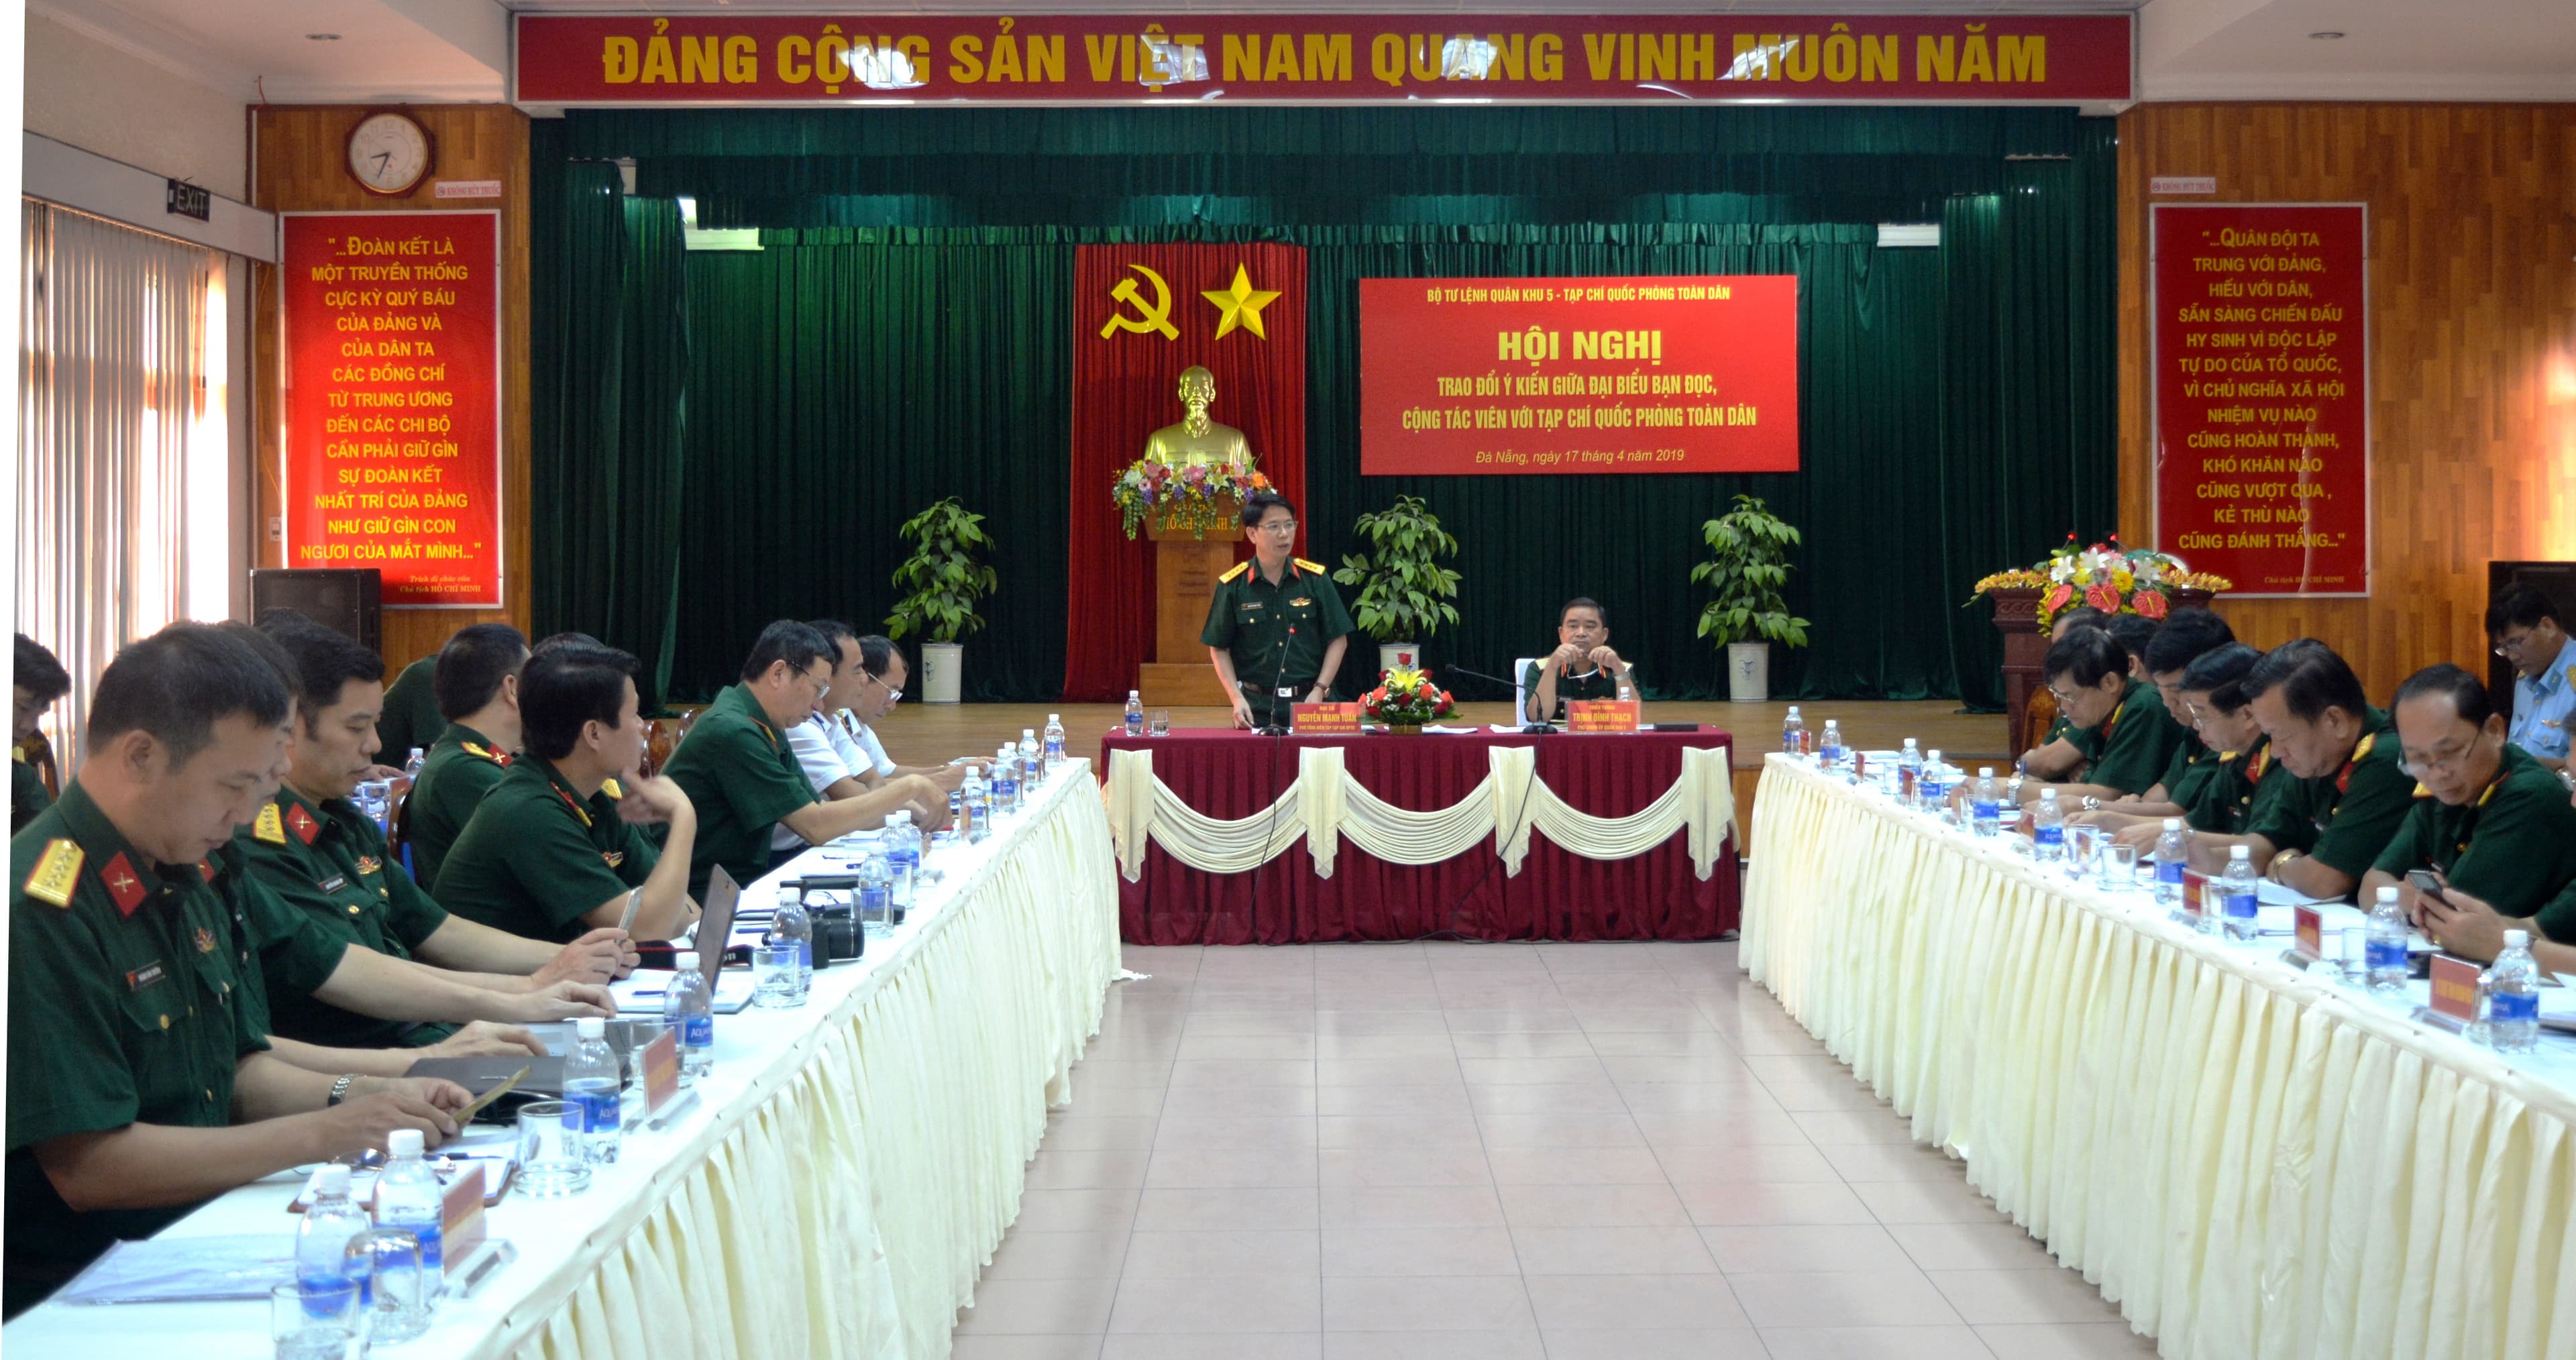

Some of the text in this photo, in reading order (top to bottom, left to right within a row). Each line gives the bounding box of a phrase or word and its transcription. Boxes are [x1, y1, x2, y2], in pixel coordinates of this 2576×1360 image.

[602, 16, 2046, 94] ĐẢNG CỘNG SẢN VIỆT NAM QUANG VINH MUÔN NĂM
[177, 186, 207, 217] EXIT
[399, 235, 430, 255] KẾT
[434, 237, 454, 254] LÀ
[2270, 229, 2297, 250] ĐỘI
[2300, 232, 2320, 246] TA
[312, 261, 468, 283] MỘT TRUYỀN THỐNG
[2193, 258, 2245, 272] TRUNG
[2249, 254, 2275, 272] VỚI
[1428, 287, 1442, 304] BỘ
[1444, 288, 1458, 302] TƯ
[1460, 287, 1487, 304] LỆNH
[1491, 286, 1519, 303] QUÂN
[1523, 288, 1544, 301] KHU
[1547, 288, 1554, 301] 5
[1564, 288, 1583, 304] TẠP
[1587, 286, 1605, 300] CHÍ
[1607, 284, 1635, 302] QUỐC
[1639, 285, 1674, 300] PHÒNG
[1677, 285, 1705, 300] TOÀN
[1708, 284, 1730, 300] DÂN
[2209, 278, 2243, 297] HIẾU
[2247, 279, 2273, 296] VỚI
[325, 288, 455, 309] CỰC KỲ QUÝ BÁU
[337, 312, 442, 331] CỦA ĐẢNG VÀ
[2214, 305, 2256, 322] SÀNG
[2261, 303, 2307, 322] CHIẾN
[2310, 303, 2342, 321] ĐẤU
[341, 337, 434, 357] CỦA DÂN TA
[1499, 325, 1661, 366] HỘI NGHỊ
[2187, 329, 2337, 350] HY SINH VÌ ĐỘC LẬP
[332, 362, 445, 382] CÁC ĐỒNG CHÍ
[2179, 357, 2200, 376] TỰ
[2204, 358, 2227, 372] DO
[2231, 352, 2262, 372] CỦA
[2267, 351, 2288, 372] TỔ
[1438, 368, 1717, 398] TRAO ĐỔI Ý KIẾN GIỮA ĐẠI BIỂU BẠN ĐỌC,
[2184, 378, 2345, 400] VÌ CHỦ NGHĨA XÃ HỘI
[327, 390, 453, 407] TỪ TRUNG ƯƠNG
[326, 414, 450, 435] ĐẾN CÁC CHI BỘ
[1403, 402, 1756, 433] CỘNG TÁC VIÊN VỚI TẠP CHÍ QUỐC PHÒNG TOÀN DÂN
[2208, 404, 2317, 425] NHIỆM VỤ NÀO
[327, 439, 458, 458] CẦN PHẢI GIỮ GÌN
[2188, 431, 2231, 448] CŨNG
[2235, 431, 2278, 447] HOÀN
[1476, 449, 1684, 465] Đà Nẵng, ngày 17 tháng 4 năm 2019
[2204, 455, 2237, 472] KHÓ
[2241, 455, 2284, 472] KHĂN
[339, 465, 443, 487] SỰ ĐOÀN KẾT
[315, 489, 468, 509] NHẤT TRÍ CỦA ĐẢNG
[2197, 481, 2241, 498] CŨNG
[2245, 483, 2286, 502] VƯỢT
[2214, 504, 2235, 522] KẺ
[2241, 505, 2271, 522] THÙ
[329, 516, 455, 534] NHƯ GIỮ GÌN CON
[354, 540, 386, 559] CỦA
[390, 539, 422, 558] MẮT
[2179, 531, 2222, 549] CŨNG
[2227, 531, 2270, 548] ĐÁNH
